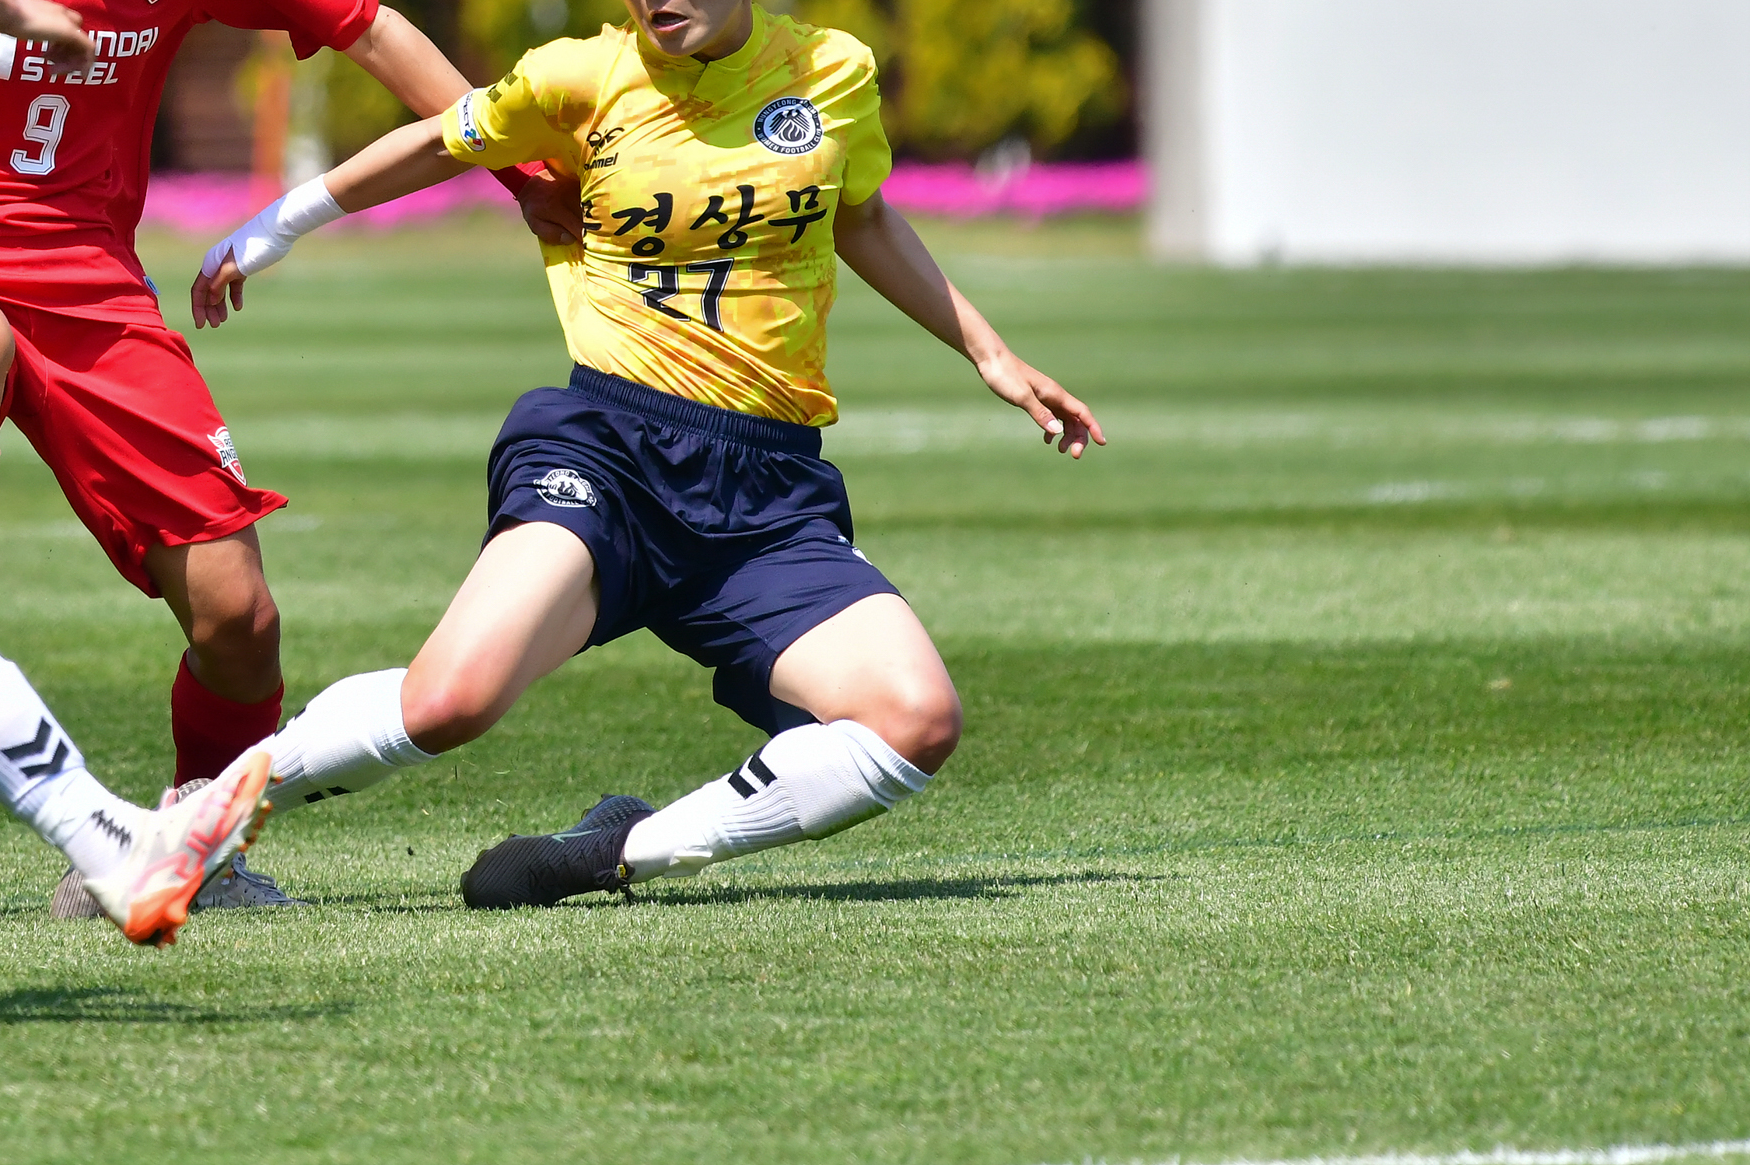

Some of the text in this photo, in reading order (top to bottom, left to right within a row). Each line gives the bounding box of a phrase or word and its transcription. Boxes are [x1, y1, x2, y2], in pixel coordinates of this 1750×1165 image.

[9, 93, 71, 176] 9
[780, 141, 817, 154] FOOTBALL
[628, 257, 735, 334] 27
